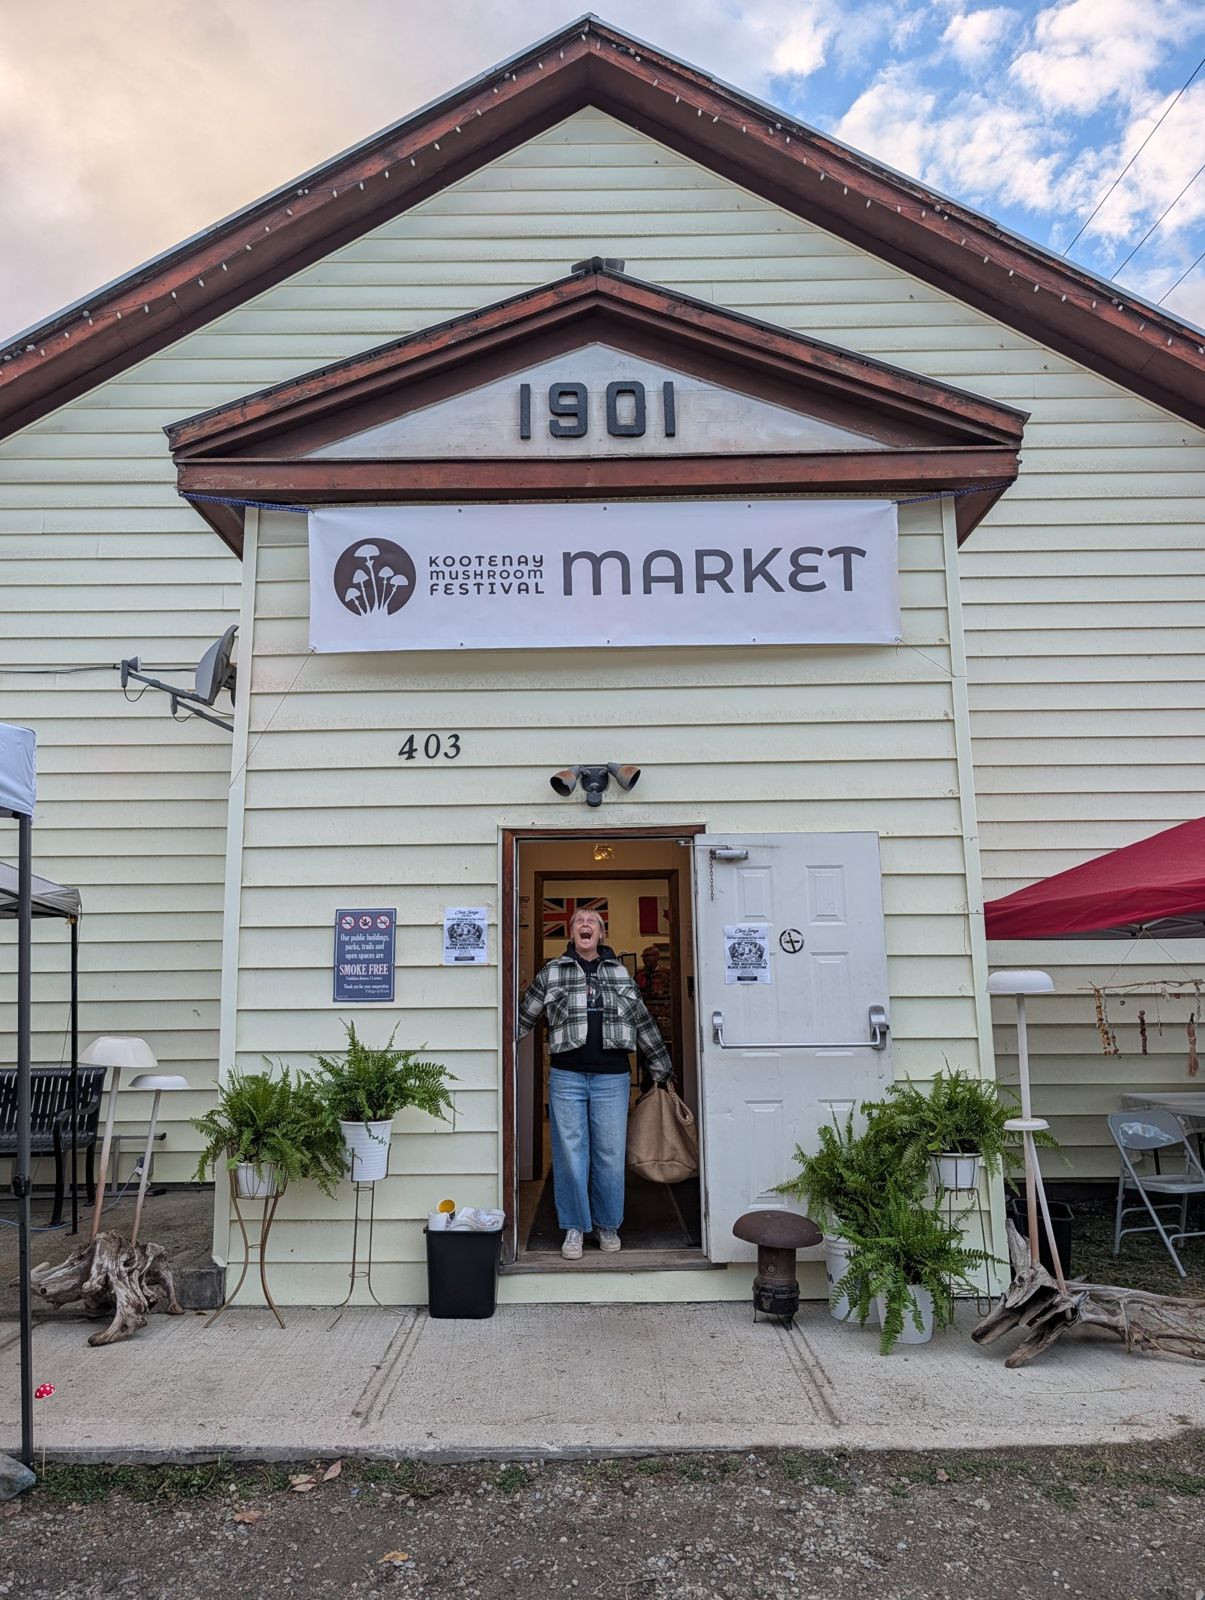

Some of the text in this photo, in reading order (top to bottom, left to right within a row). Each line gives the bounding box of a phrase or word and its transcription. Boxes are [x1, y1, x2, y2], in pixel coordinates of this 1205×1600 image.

[520, 381, 676, 439] 1901
[429, 555, 544, 568] KOOTENAY
[430, 569, 544, 581] MUSHROOM
[562, 546, 867, 596] MARKET
[430, 582, 545, 595] FESTIVAL
[398, 733, 461, 760] 403
[351, 933, 366, 942] public
[345, 942, 360, 951] parks,
[340, 964, 388, 976] SMOKE FREE
